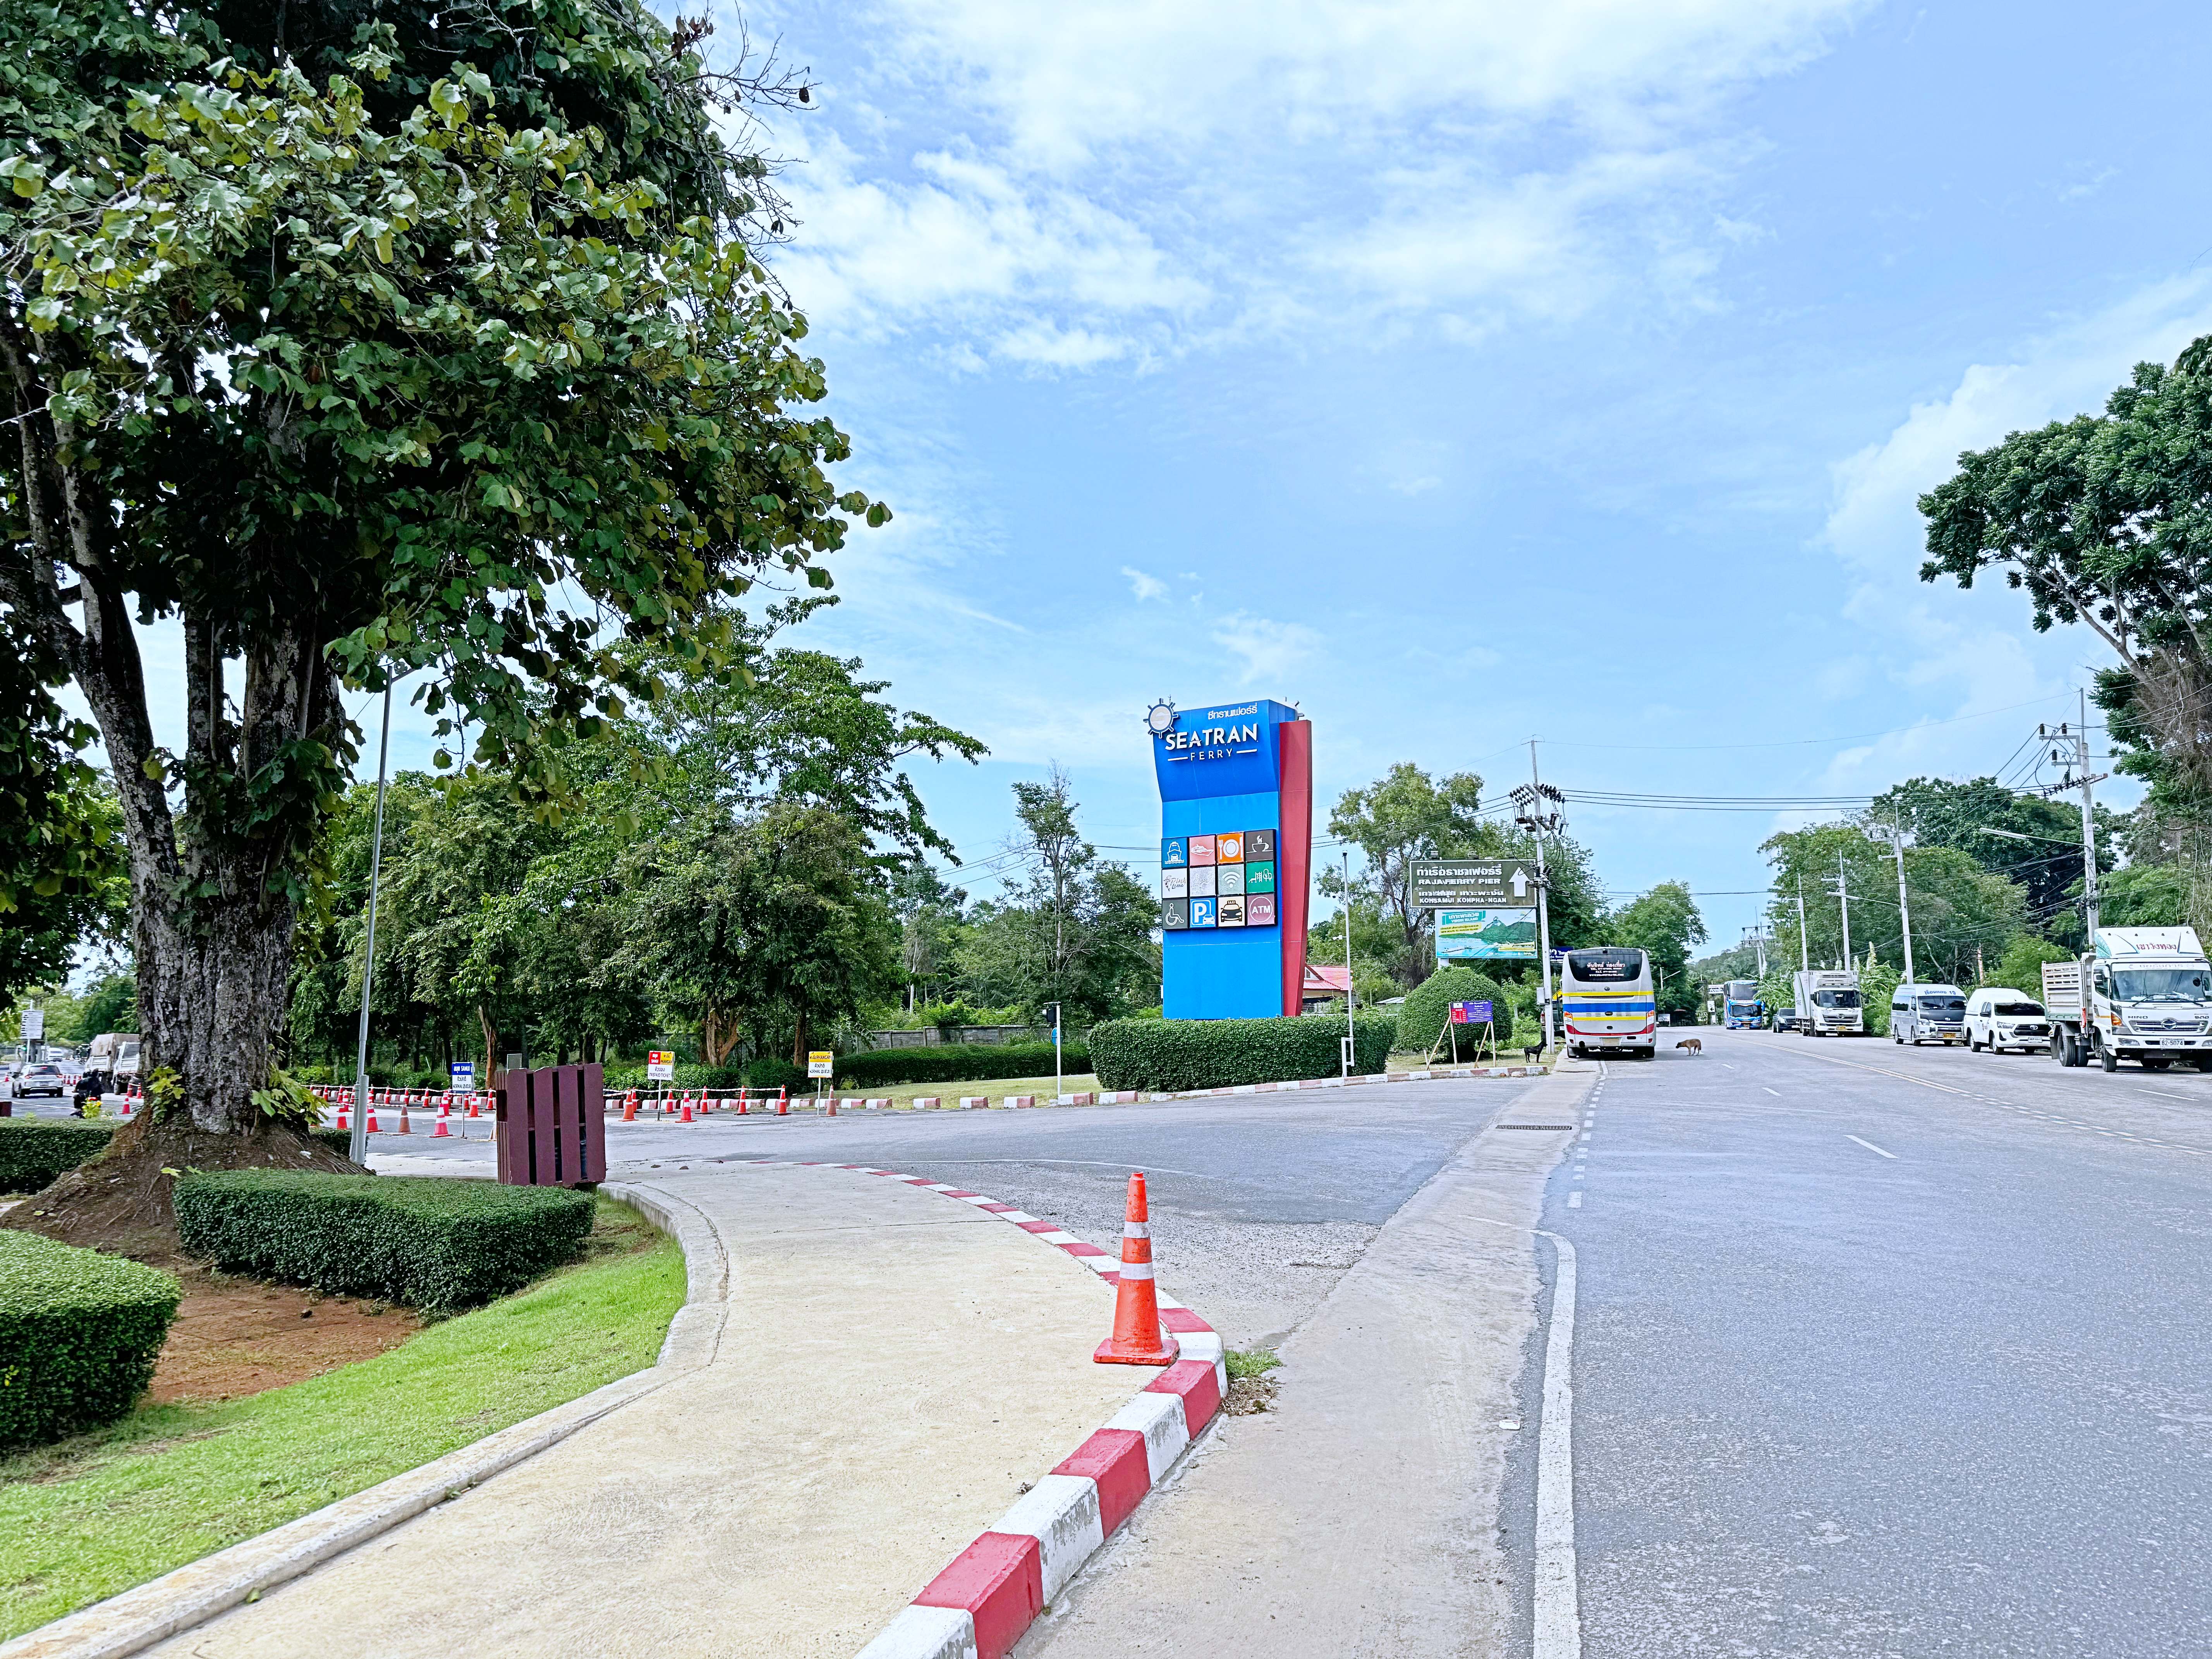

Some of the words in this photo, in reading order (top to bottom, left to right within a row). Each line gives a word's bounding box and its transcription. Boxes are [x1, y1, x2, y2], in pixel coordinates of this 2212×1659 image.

[1207, 702, 1257, 720] ซีทรานเฟอร์รี่
[1165, 723, 1258, 750] SEATRAN
[1190, 748, 1233, 761] FERRY
[1417, 864, 1502, 876] ท่าเรือราชาเฟอร์รี่
[1252, 905, 1271, 914] ATM
